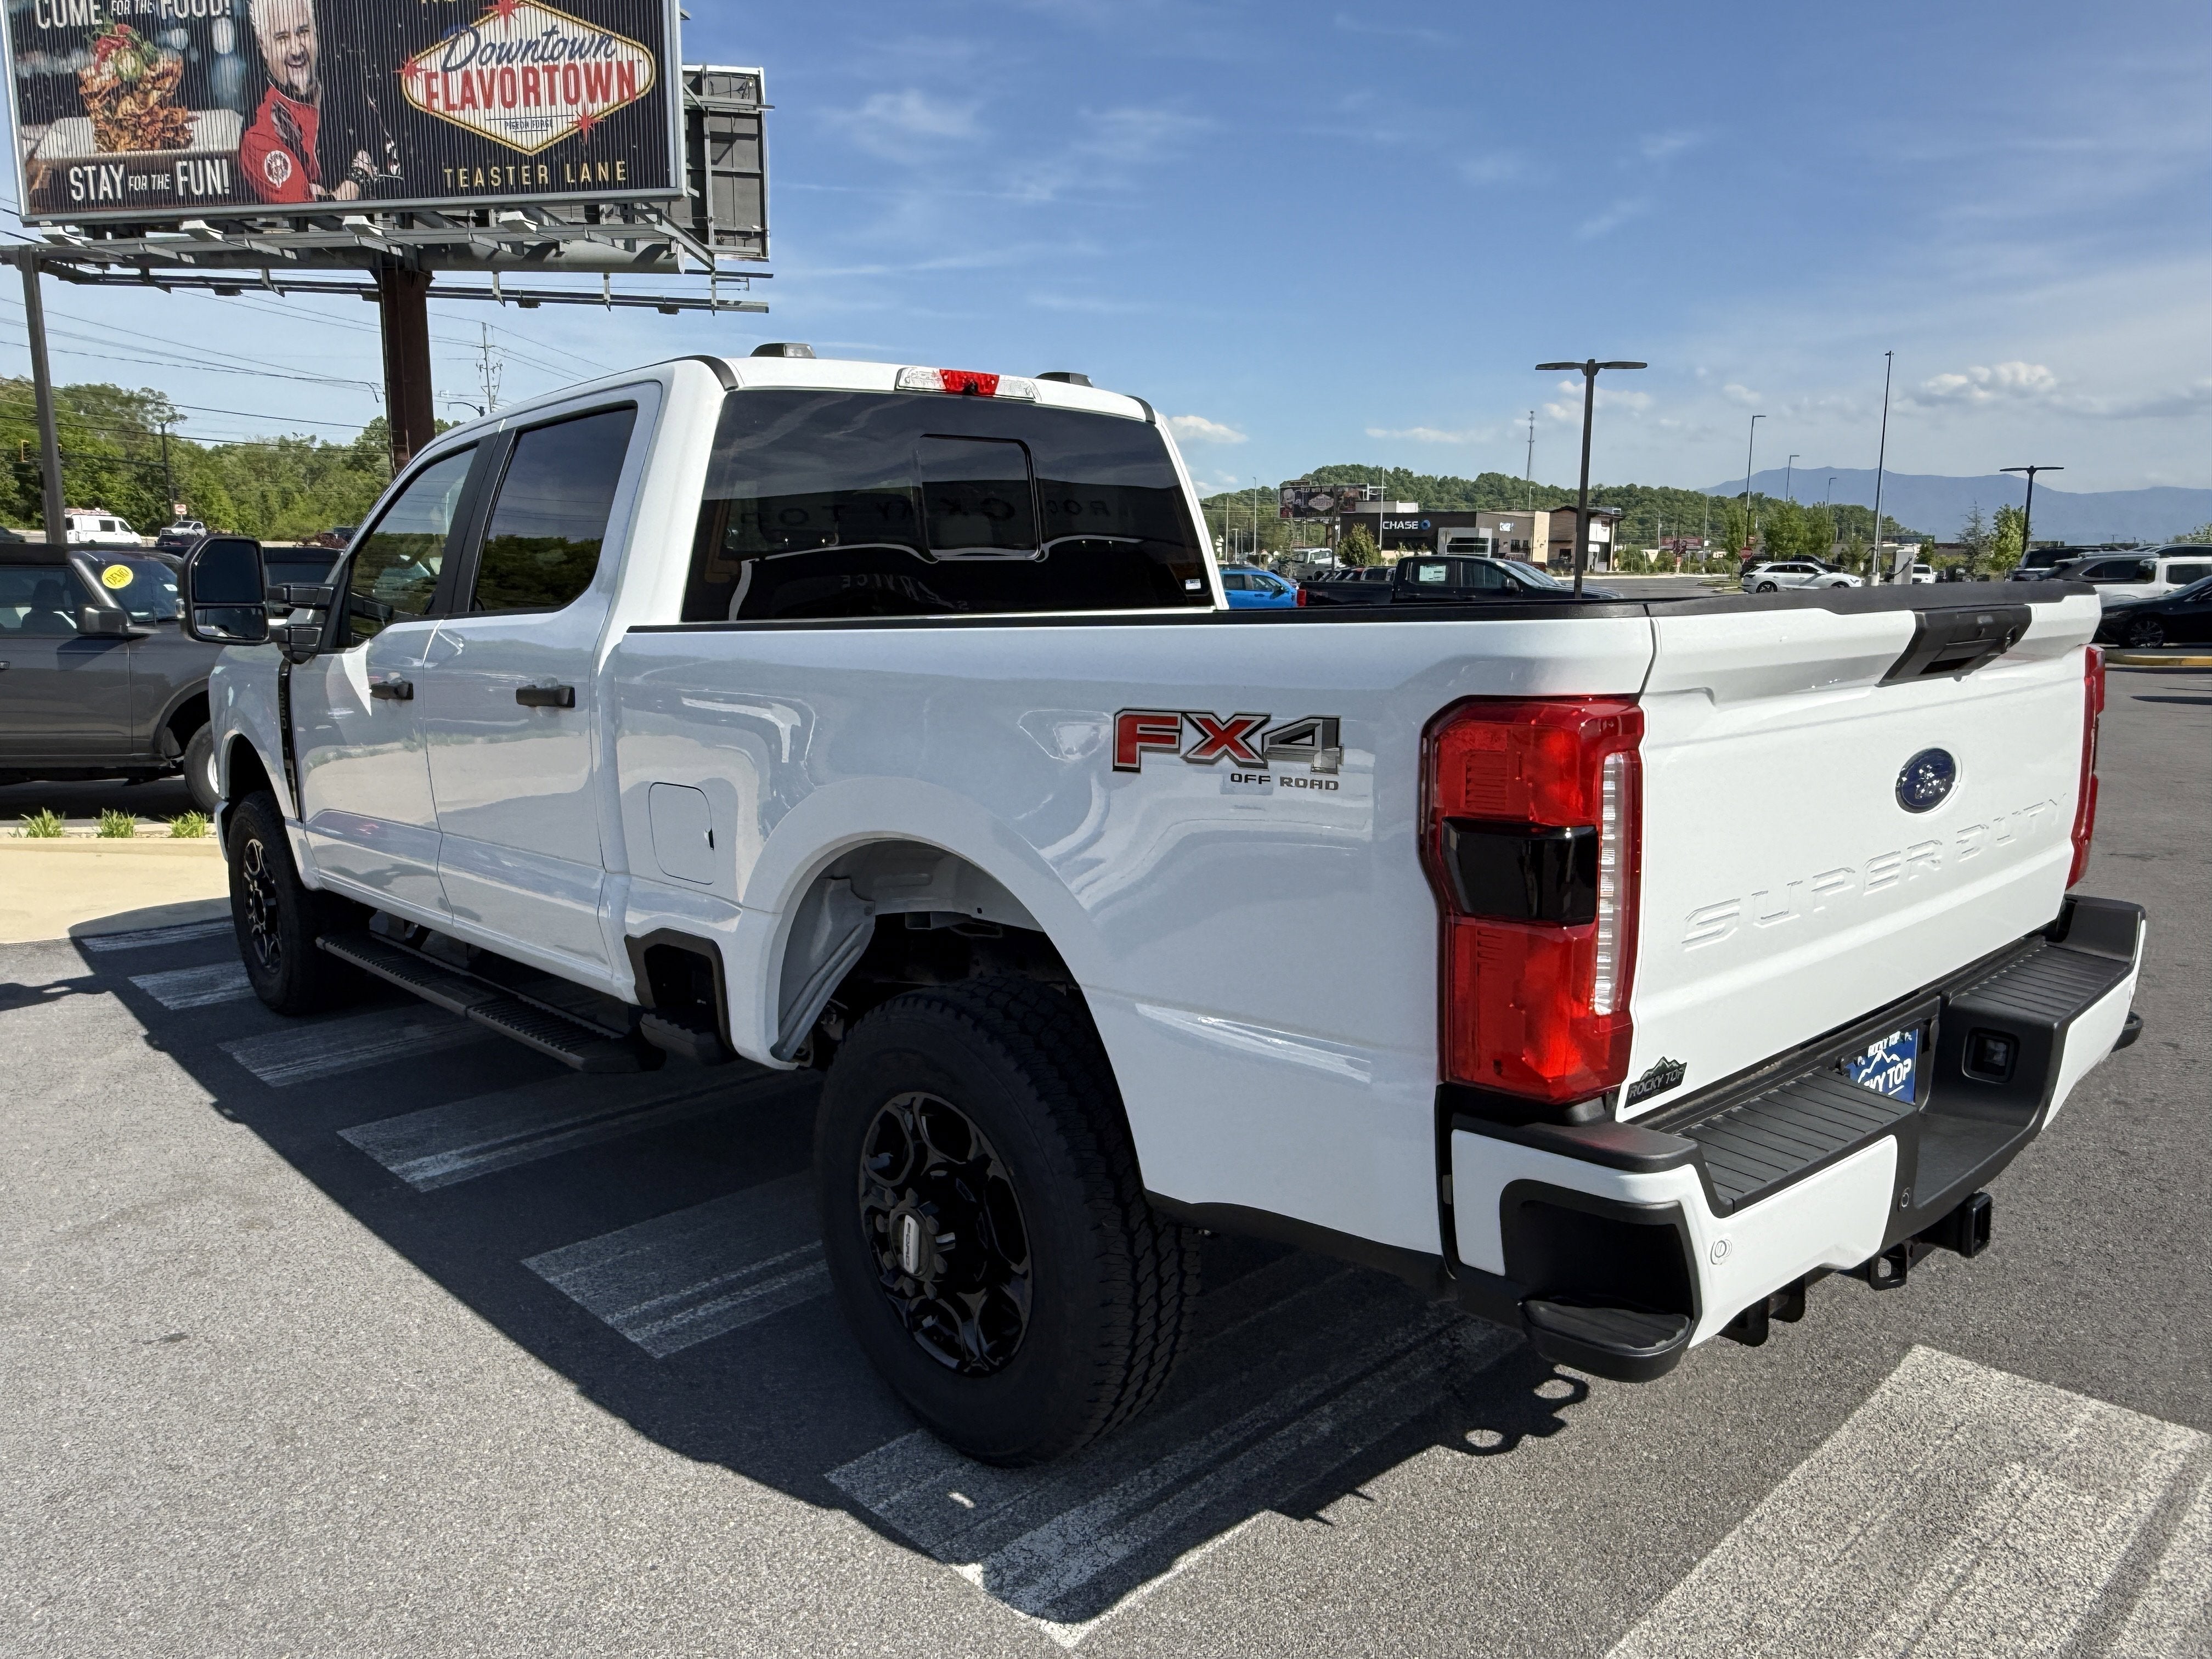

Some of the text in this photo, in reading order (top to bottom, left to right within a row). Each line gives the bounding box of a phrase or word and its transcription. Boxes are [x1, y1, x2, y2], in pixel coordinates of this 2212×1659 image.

[36, 0, 104, 28] COME
[441, 25, 616, 72] Downtown
[423, 60, 637, 111] FLAVORTOWN
[69, 159, 230, 201] STAY FOR THE FUN!
[443, 161, 627, 189] TEASTER LANE
[1382, 521, 1419, 530] CHASE
[1113, 707, 1344, 774] FX4
[1230, 772, 1340, 791] OFF ROAD
[1681, 839, 1943, 952] SUPER
[1629, 1068, 1685, 1098] ROCKY TOP
[1887, 1058, 1912, 1088] TOP
